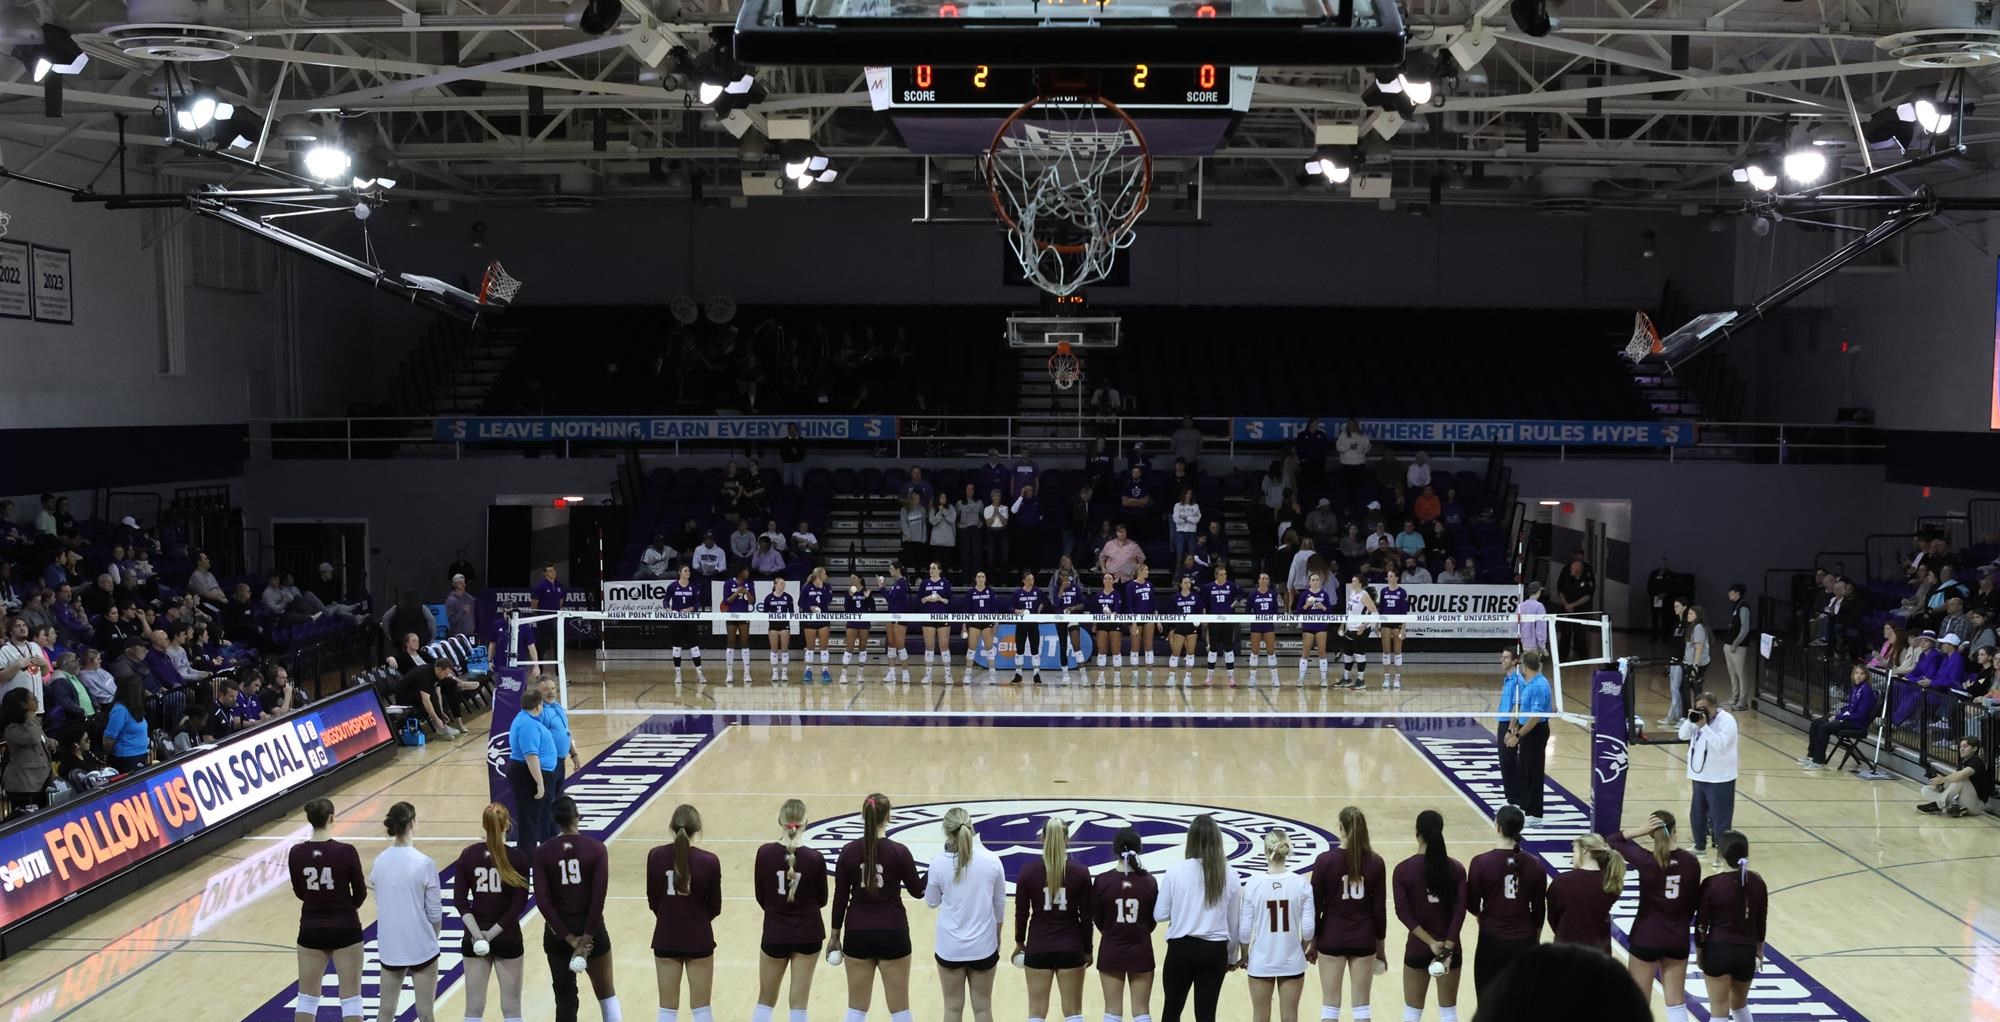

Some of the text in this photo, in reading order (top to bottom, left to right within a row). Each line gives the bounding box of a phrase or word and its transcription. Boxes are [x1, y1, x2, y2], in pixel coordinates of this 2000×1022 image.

[917, 64, 932, 88] 0
[974, 65, 988, 88] 2
[1133, 64, 1148, 88] 2
[1200, 64, 1216, 88] 0
[903, 90, 936, 102] SCORE
[1186, 91, 1219, 103] SCORE
[0, 265, 21, 284] 2022
[43, 272, 64, 290] 2023
[479, 422, 544, 438] LEAVE
[550, 422, 647, 440] NOTHING,
[654, 422, 709, 438] EARN
[1279, 423, 1326, 440] THS
[1358, 424, 1434, 440] WHERE
[1442, 424, 1512, 440] HEART
[1519, 425, 1585, 441] RULES
[1592, 426, 1648, 442] HYPE
[609, 584, 666, 601] molte
[682, 596, 687, 604] 1
[815, 595, 821, 603] 4
[1063, 596, 1072, 604] 13
[1141, 592, 1150, 600] 15
[1215, 595, 1225, 603] 18
[856, 600, 862, 608] 5
[1025, 601, 1033, 609] 11
[1408, 595, 1519, 613] RCULES TIRES
[597, 733, 708, 768] HIGH
[44, 791, 160, 881] FOLLOW
[155, 777, 197, 828] US
[193, 762, 232, 811] ON
[229, 735, 304, 795] SOCIAL
[320, 711, 377, 748] BIGSOUTHSPORTS
[303, 867, 335, 890] 24
[474, 867, 502, 893] 20
[558, 859, 580, 884] 19
[1341, 874, 1366, 901] 10
[1504, 874, 1519, 900] 8
[1664, 875, 1681, 899] 5
[1043, 887, 1068, 911] 14
[1115, 898, 1139, 923] 13
[1266, 899, 1290, 934] 11
